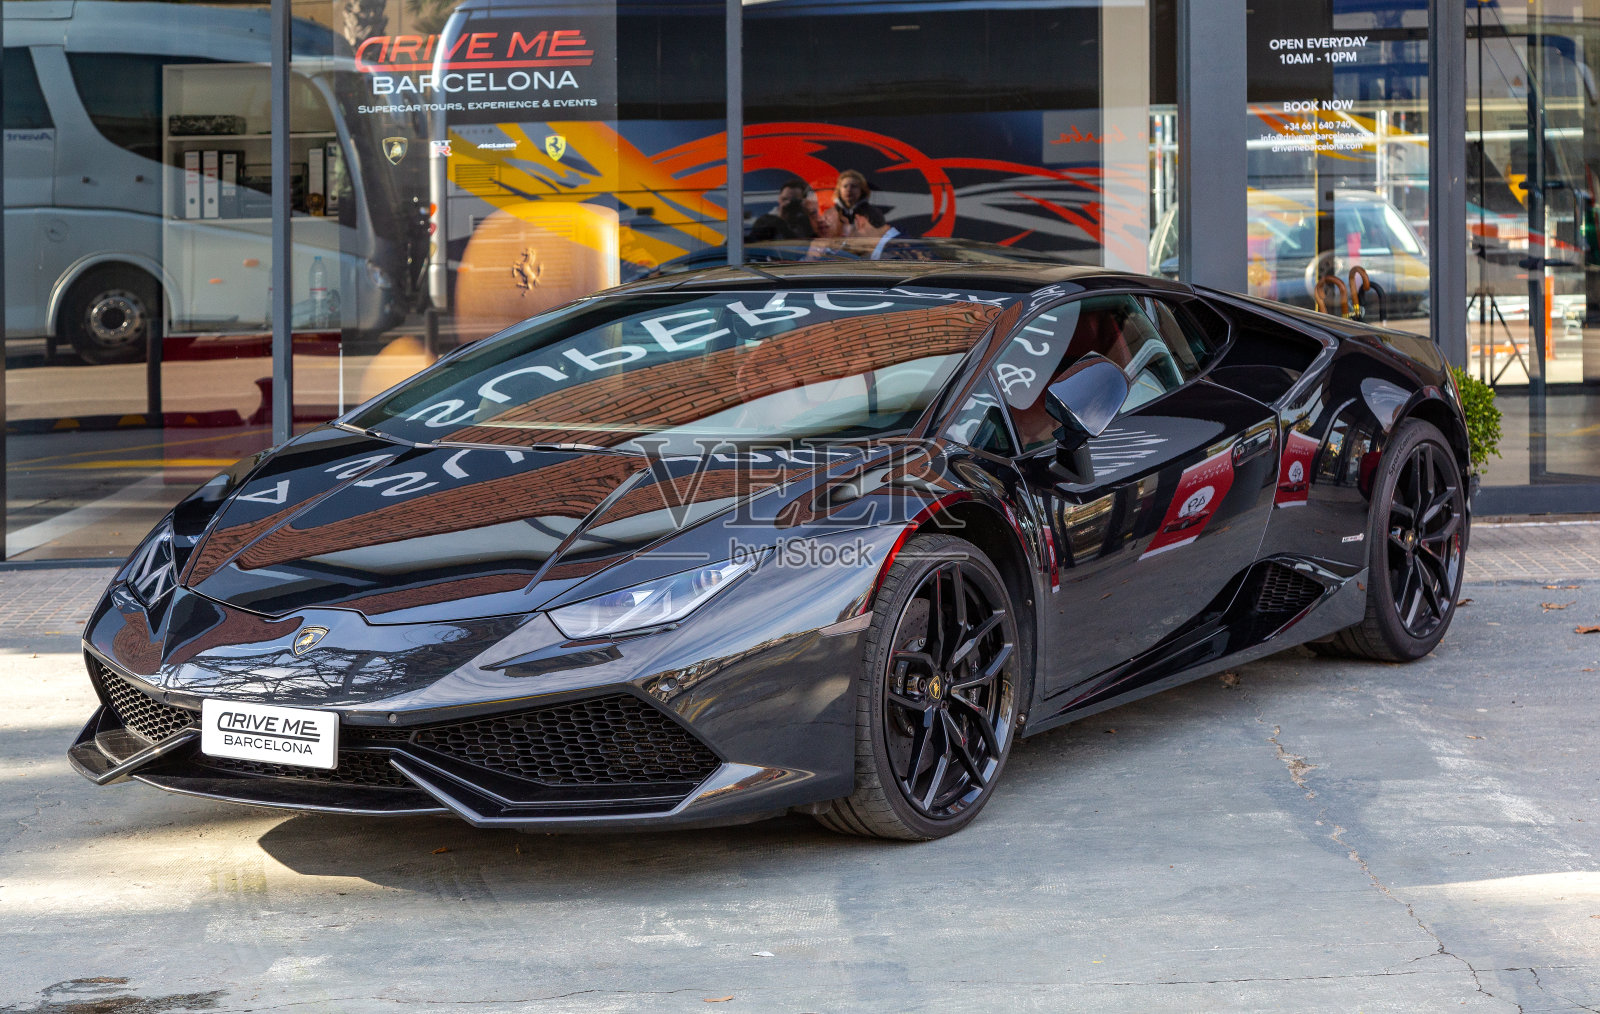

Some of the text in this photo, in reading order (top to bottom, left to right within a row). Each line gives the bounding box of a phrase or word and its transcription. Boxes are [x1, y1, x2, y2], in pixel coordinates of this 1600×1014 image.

[1269, 36, 1368, 50] OPEN EVERYDAY
[355, 30, 594, 72] DRIVE ME
[1280, 53, 1313, 64] 10AM
[1324, 51, 1357, 63] 10PM
[373, 70, 579, 95] BARCELONA
[358, 98, 598, 114] SUPERCAR TOURS, EXPERIENCE & EVENTS
[1283, 99, 1353, 112] BOOK NOW
[1284, 120, 1351, 131] +34 661 640 740
[477, 141, 518, 150] McLaren
[1272, 142, 1363, 152] drivemebarcelona.com
[217, 711, 320, 737] DRIVE ME
[224, 734, 313, 755] BARCELONA
